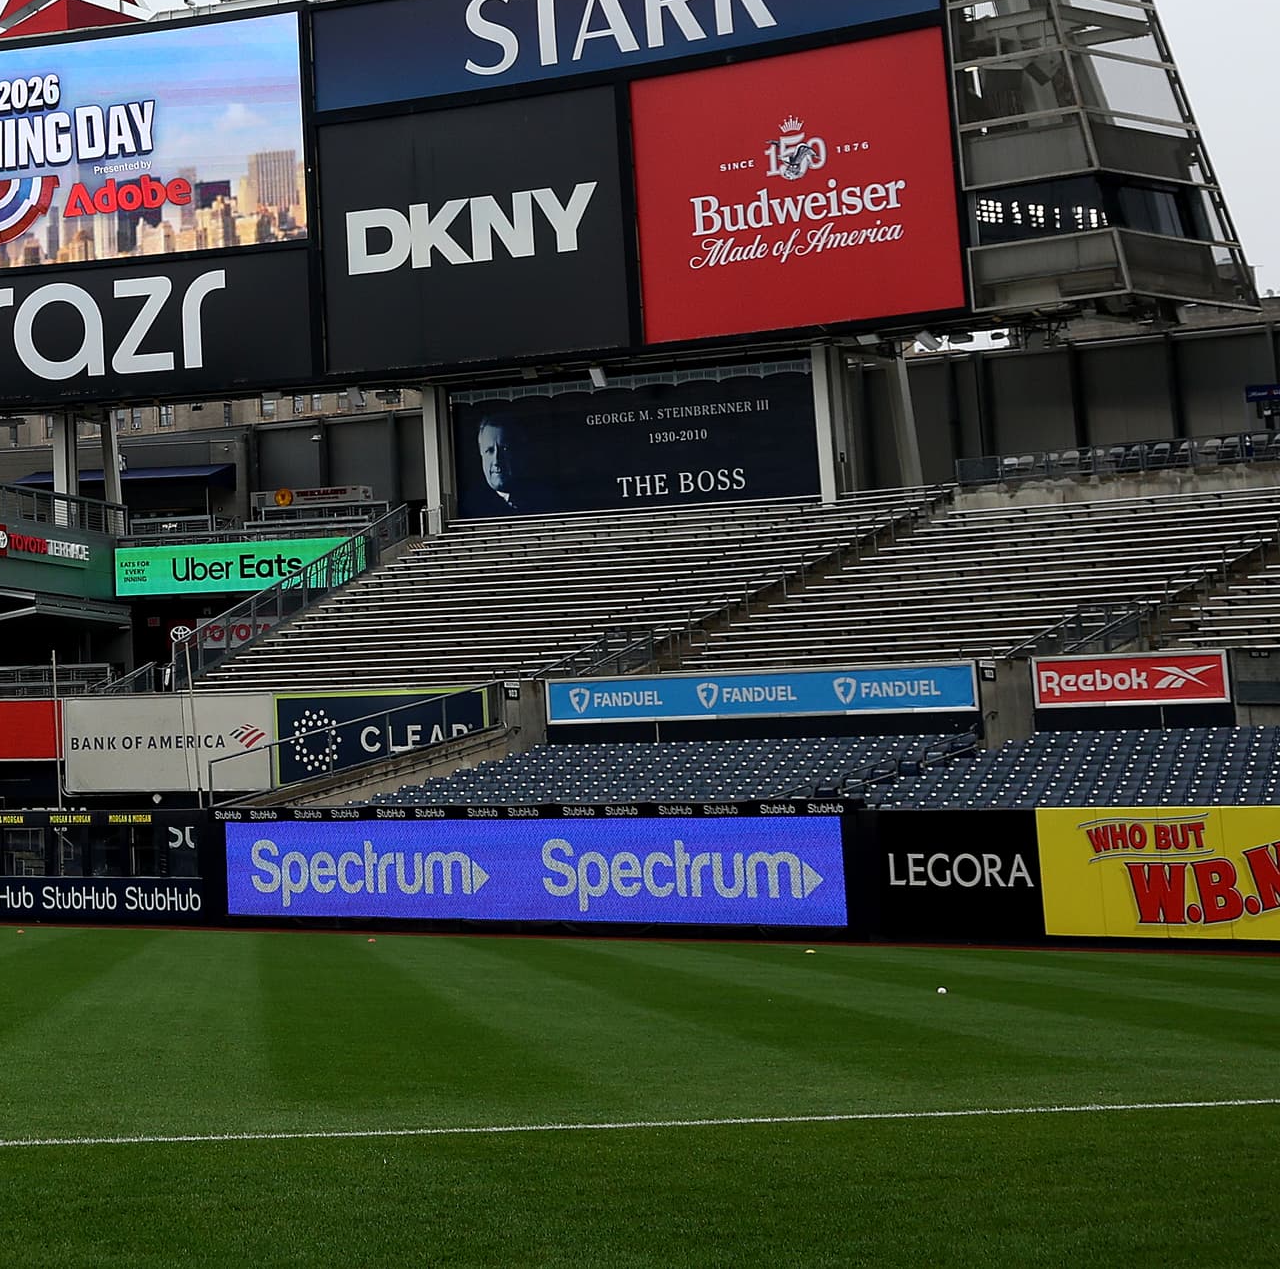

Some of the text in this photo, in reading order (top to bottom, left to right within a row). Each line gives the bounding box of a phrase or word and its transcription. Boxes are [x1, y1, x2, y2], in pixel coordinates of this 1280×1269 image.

[74, 100, 155, 162] DAY
[94, 160, 151, 175] Presented by
[720, 160, 755, 172] SINCE
[836, 142, 869, 153] 1876
[63, 175, 191, 217] Adobe
[690, 179, 906, 236] Budweiser
[346, 182, 597, 275] DKNY
[690, 220, 904, 269] Made of America
[586, 399, 769, 426] GEORGE M. STEINBRENNER III
[648, 428, 708, 444] 1930-2010
[617, 468, 747, 498] THE BOSS
[8, 533, 48, 554] TOYOTA
[172, 554, 302, 581] Uber Eats
[723, 685, 797, 703] FANDUEL
[861, 679, 941, 698] FANDUEL
[1041, 667, 1148, 696] Reebok
[593, 691, 663, 707] FANDUEL
[71, 734, 226, 751] BANK OF AMERICA
[215, 810, 241, 819] StubHub
[294, 809, 322, 819] StubHub
[376, 808, 405, 818] StubHub
[467, 807, 498, 818] StubHub
[562, 806, 595, 817] StubHub
[658, 805, 692, 816] StubHub
[760, 803, 796, 815] StubHub
[1087, 821, 1205, 854] WHO BUT
[250, 839, 473, 907] Spectrum
[541, 838, 804, 911] Spectrum
[888, 852, 1035, 888] LEGORA
[42, 886, 117, 910] StubHub
[125, 887, 201, 911] StubHub
